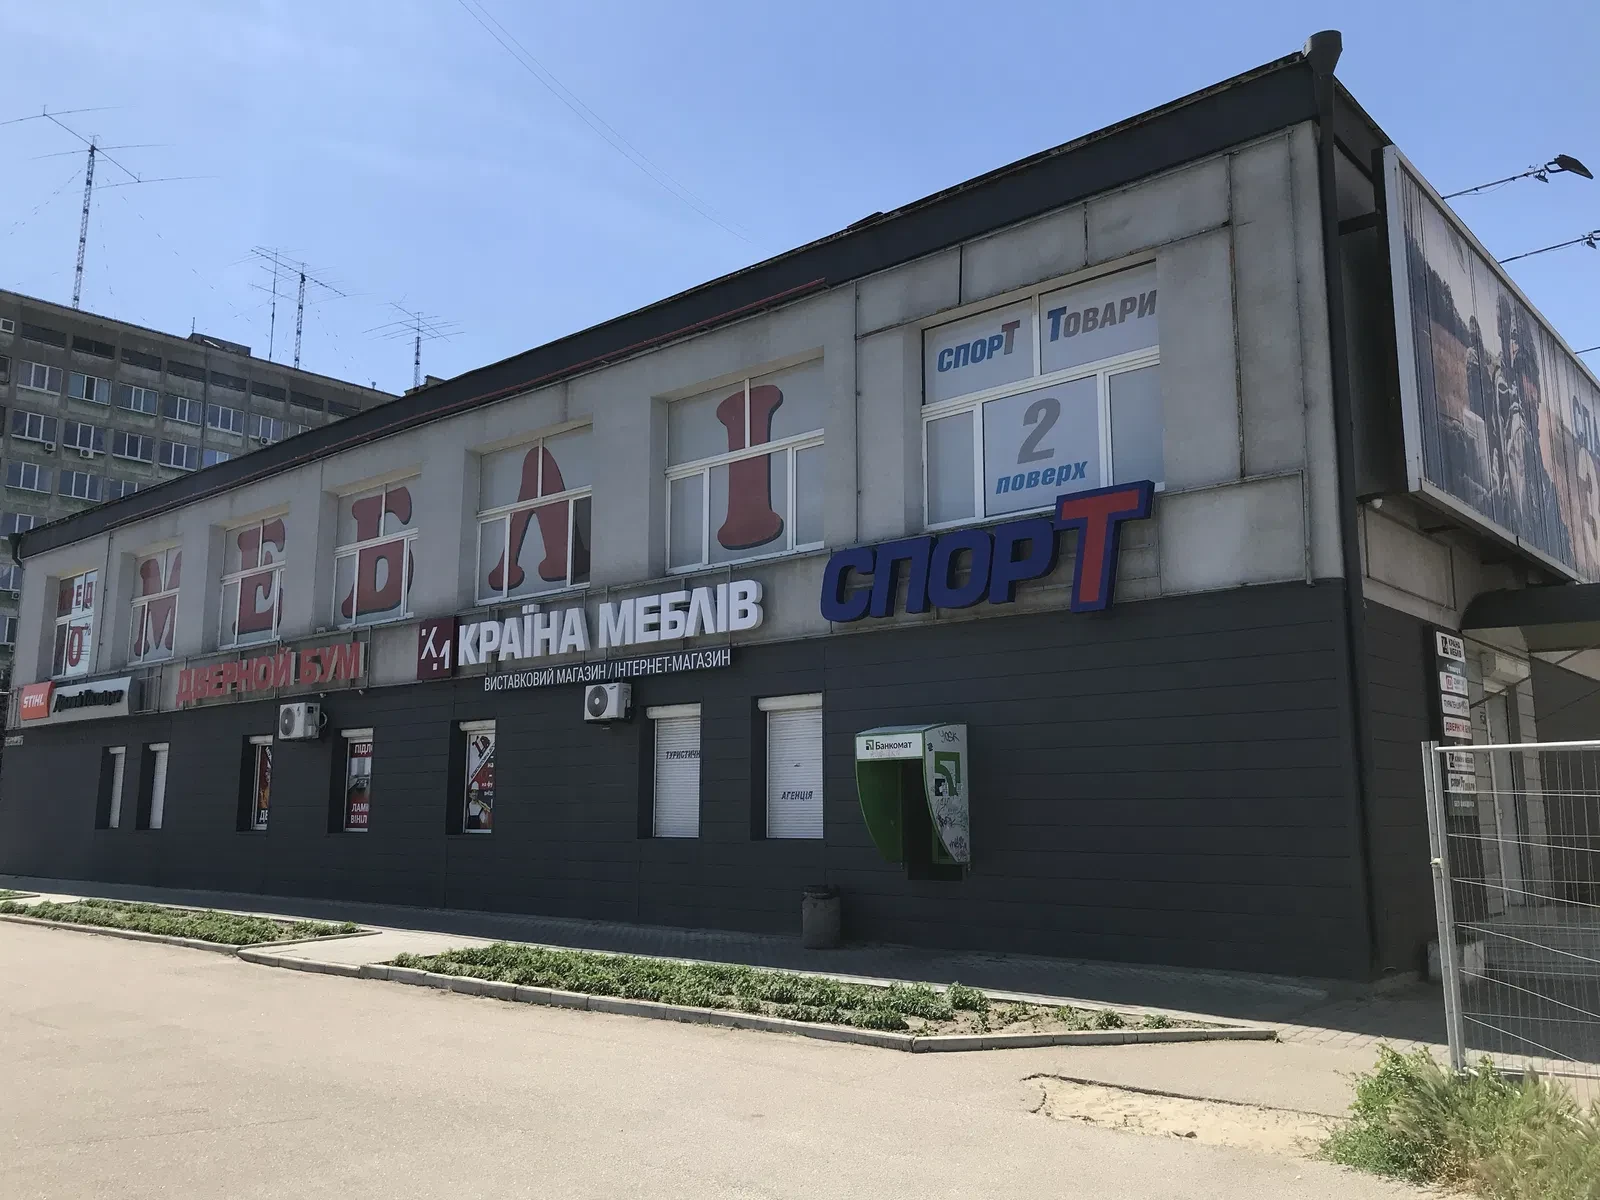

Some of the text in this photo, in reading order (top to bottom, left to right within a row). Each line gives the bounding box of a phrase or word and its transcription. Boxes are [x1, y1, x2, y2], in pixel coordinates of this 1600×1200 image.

[1047, 289, 1157, 342] ТОВАРИ
[1016, 397, 1061, 465] 2
[995, 460, 1088, 495] поверх
[820, 480, 1155, 623] СПОРТ
[458, 579, 763, 667] КРАЇНА МЕБЛІВ
[175, 646, 297, 708] ДВЕРНОЙ
[301, 641, 368, 685] БУМ
[484, 668, 555, 692] ВИСТАВКОВИЙ
[556, 663, 606, 684] МАГАЗИН
[615, 649, 731, 678] ІНТЕРНЕТ-МАГАЗИН
[23, 693, 45, 709] STIHL
[875, 741, 913, 750] Банкомат
[781, 790, 813, 802] АГЕНЦІЯ
